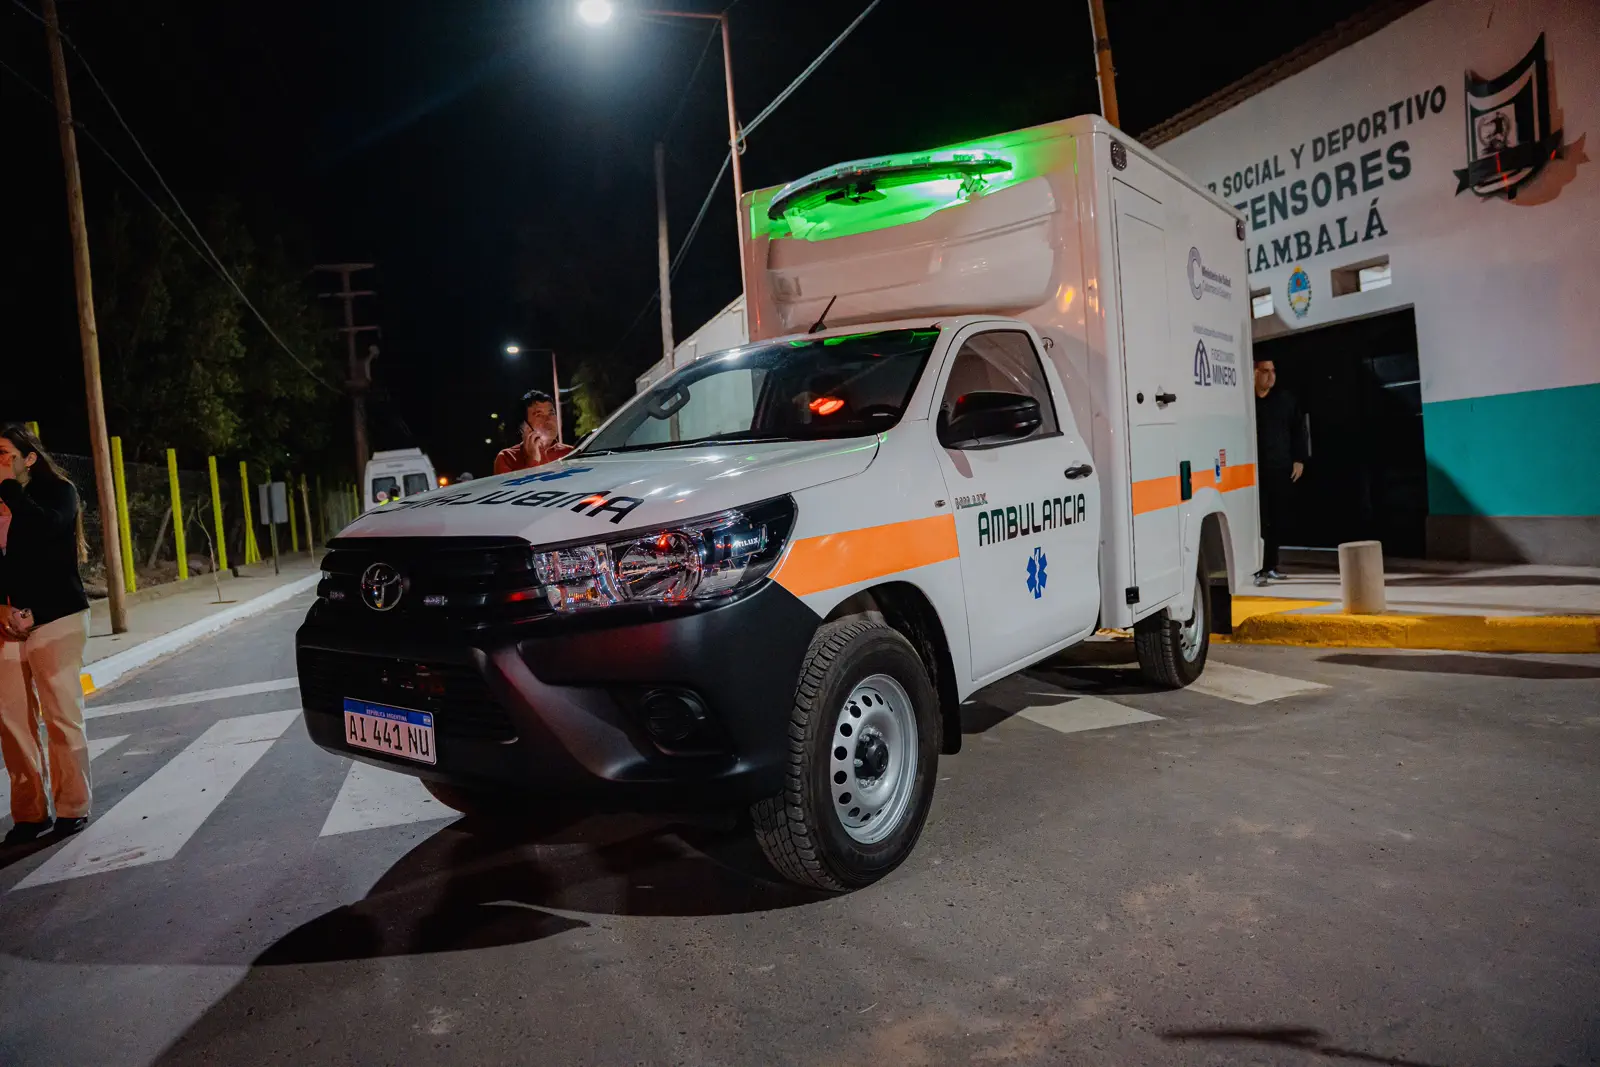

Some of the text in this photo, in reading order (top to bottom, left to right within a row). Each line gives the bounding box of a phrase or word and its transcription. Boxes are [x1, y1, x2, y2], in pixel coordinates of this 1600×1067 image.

[1222, 84, 1447, 198] SOCIAL Y DEPORTIVO
[1212, 364, 1237, 387] MINERO
[978, 493, 1085, 547] AMBULANCIA
[350, 715, 430, 757] AI 441 NU
